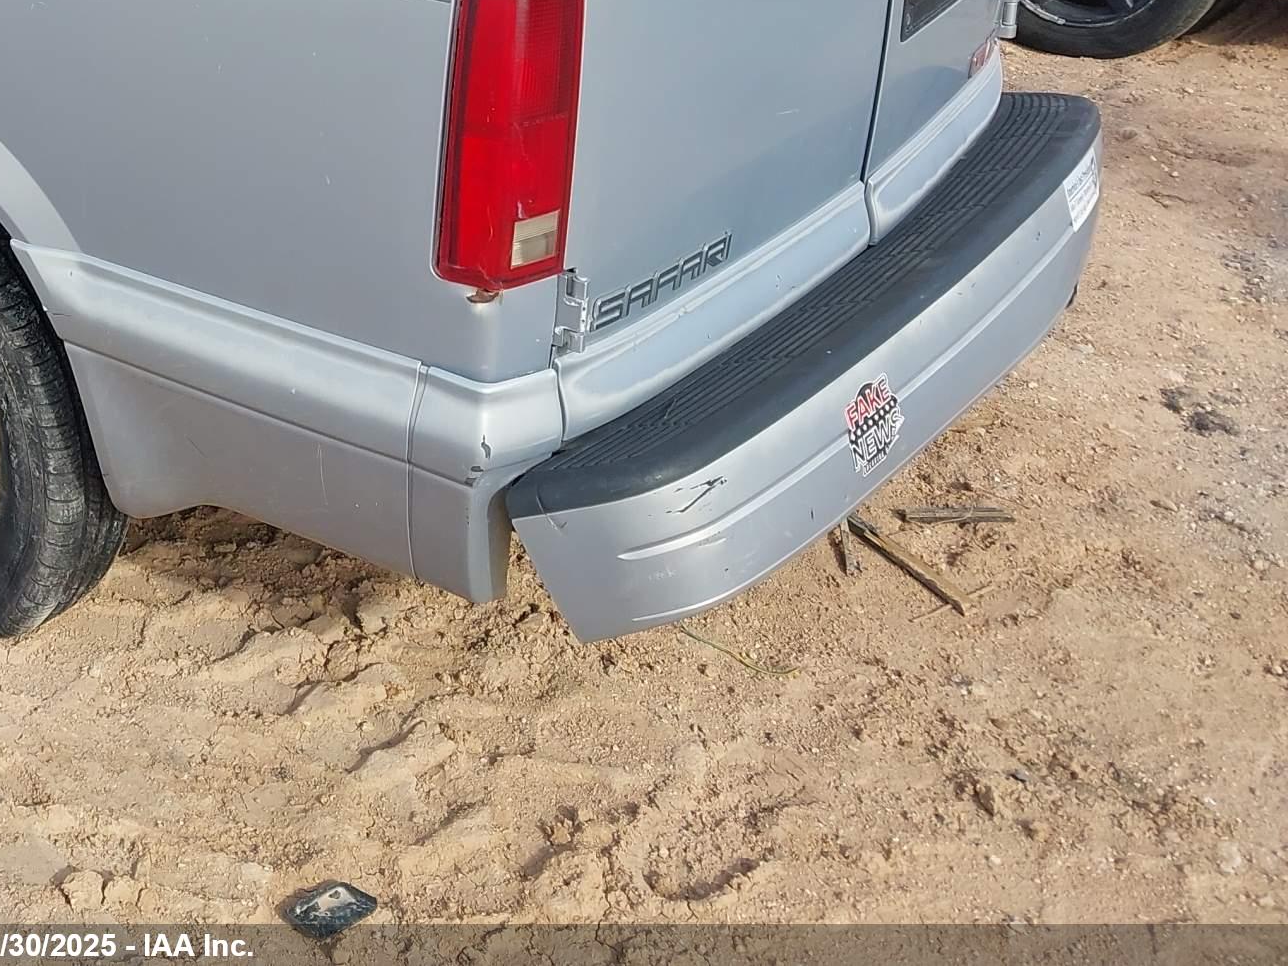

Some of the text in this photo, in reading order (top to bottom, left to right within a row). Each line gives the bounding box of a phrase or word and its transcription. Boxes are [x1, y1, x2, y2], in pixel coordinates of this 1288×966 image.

[590, 232, 732, 332] SAFARI
[844, 375, 891, 432] FAKE
[851, 408, 902, 473] NEWS
